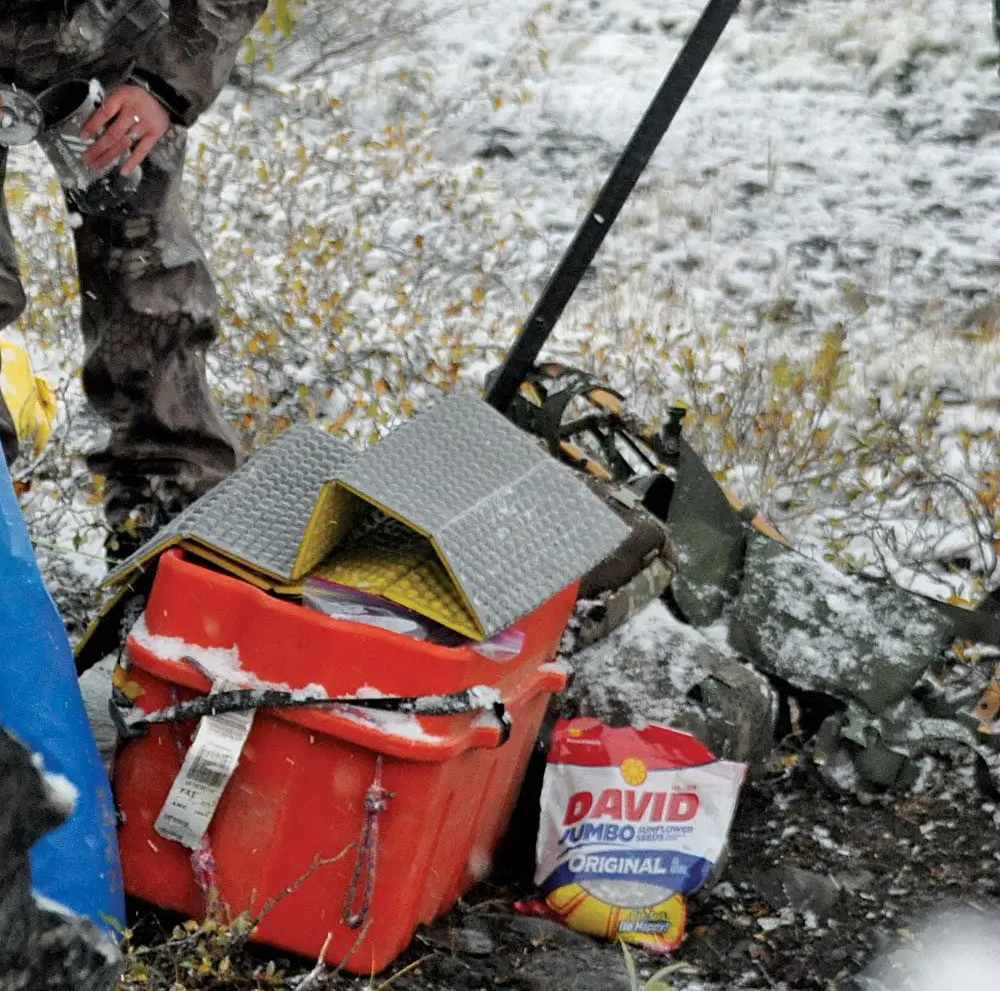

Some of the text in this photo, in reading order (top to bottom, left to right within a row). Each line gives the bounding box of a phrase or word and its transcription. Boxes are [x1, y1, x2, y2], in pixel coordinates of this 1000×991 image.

[562, 788, 699, 826] DAVID
[558, 823, 635, 845] JUMBO
[568, 855, 666, 874] ORIGINAL
